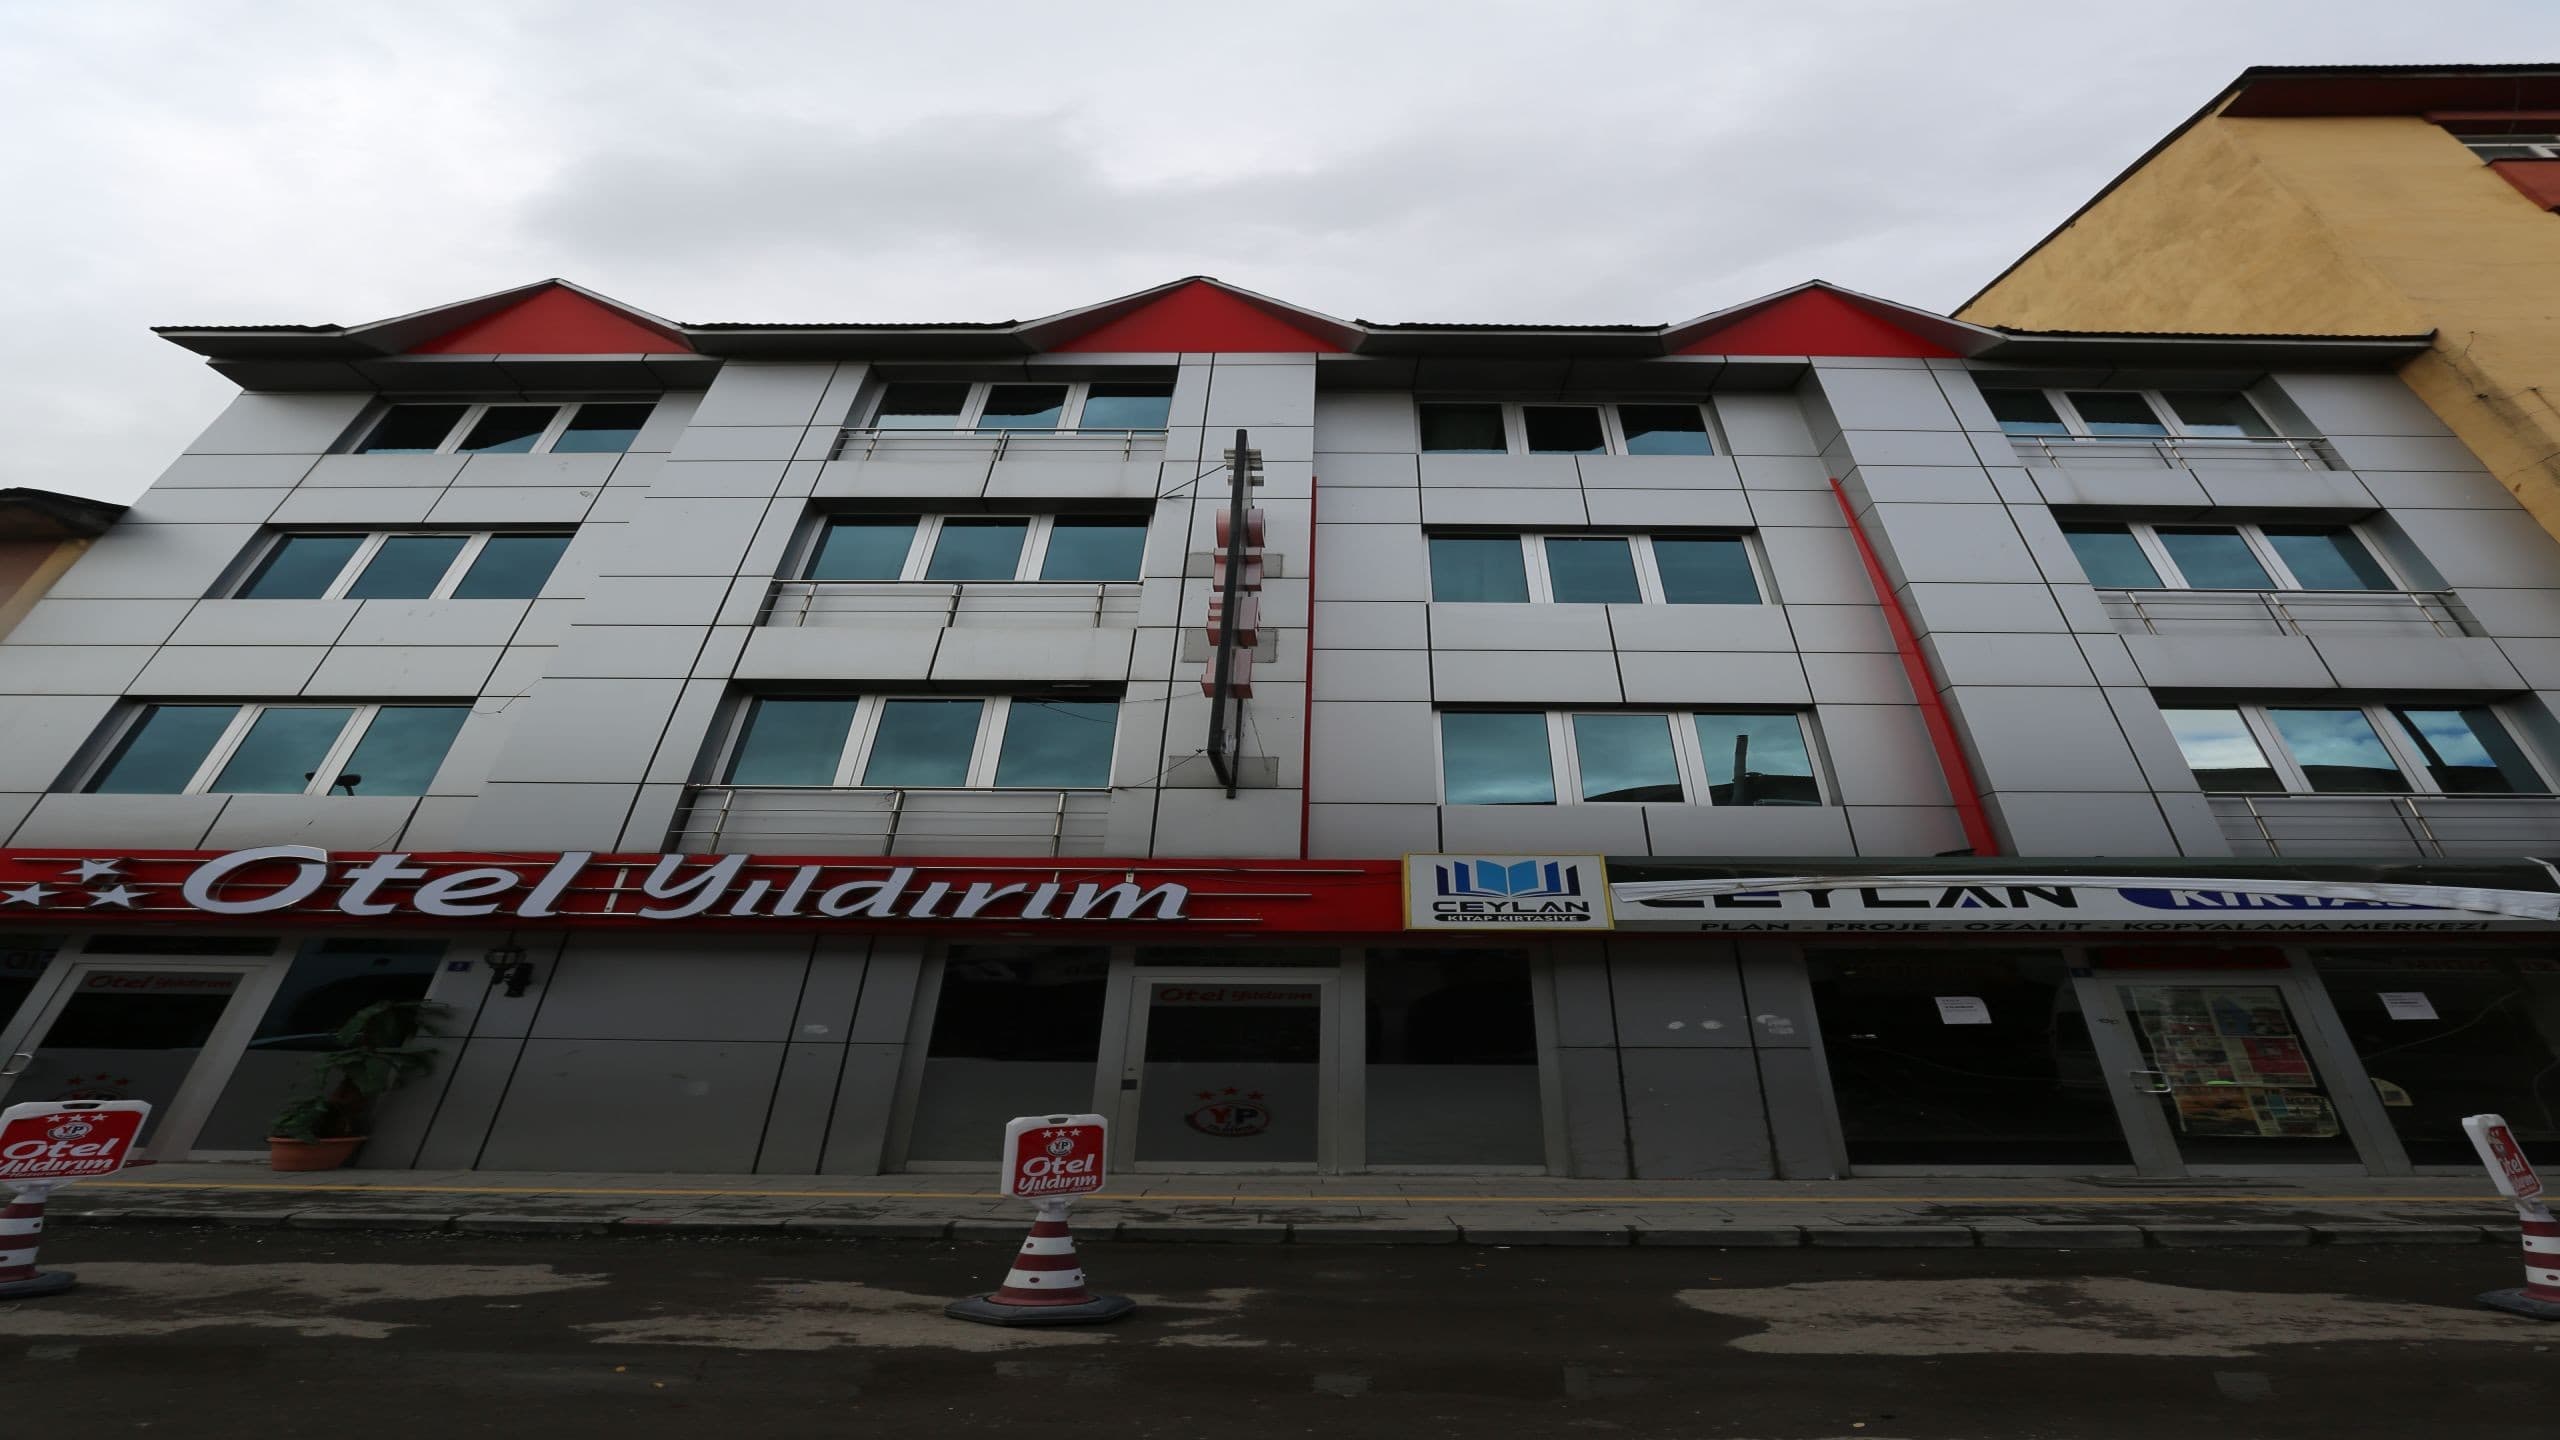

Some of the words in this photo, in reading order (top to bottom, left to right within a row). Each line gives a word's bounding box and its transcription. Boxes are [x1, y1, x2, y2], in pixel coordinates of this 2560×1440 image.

[183, 845, 593, 918] Otel
[638, 853, 1190, 920] Yıldırım
[1432, 901, 1590, 913] CEYLAN
[1640, 885, 2079, 908] EYLAN
[1700, 922, 1791, 931] PLAN
[1825, 922, 1931, 931] PROJE
[2123, 922, 2330, 931] KOPYALAMA
[1159, 987, 1228, 1003] Otel
[2, 1137, 121, 1160] Otel
[1022, 1153, 1096, 1176] Otel
